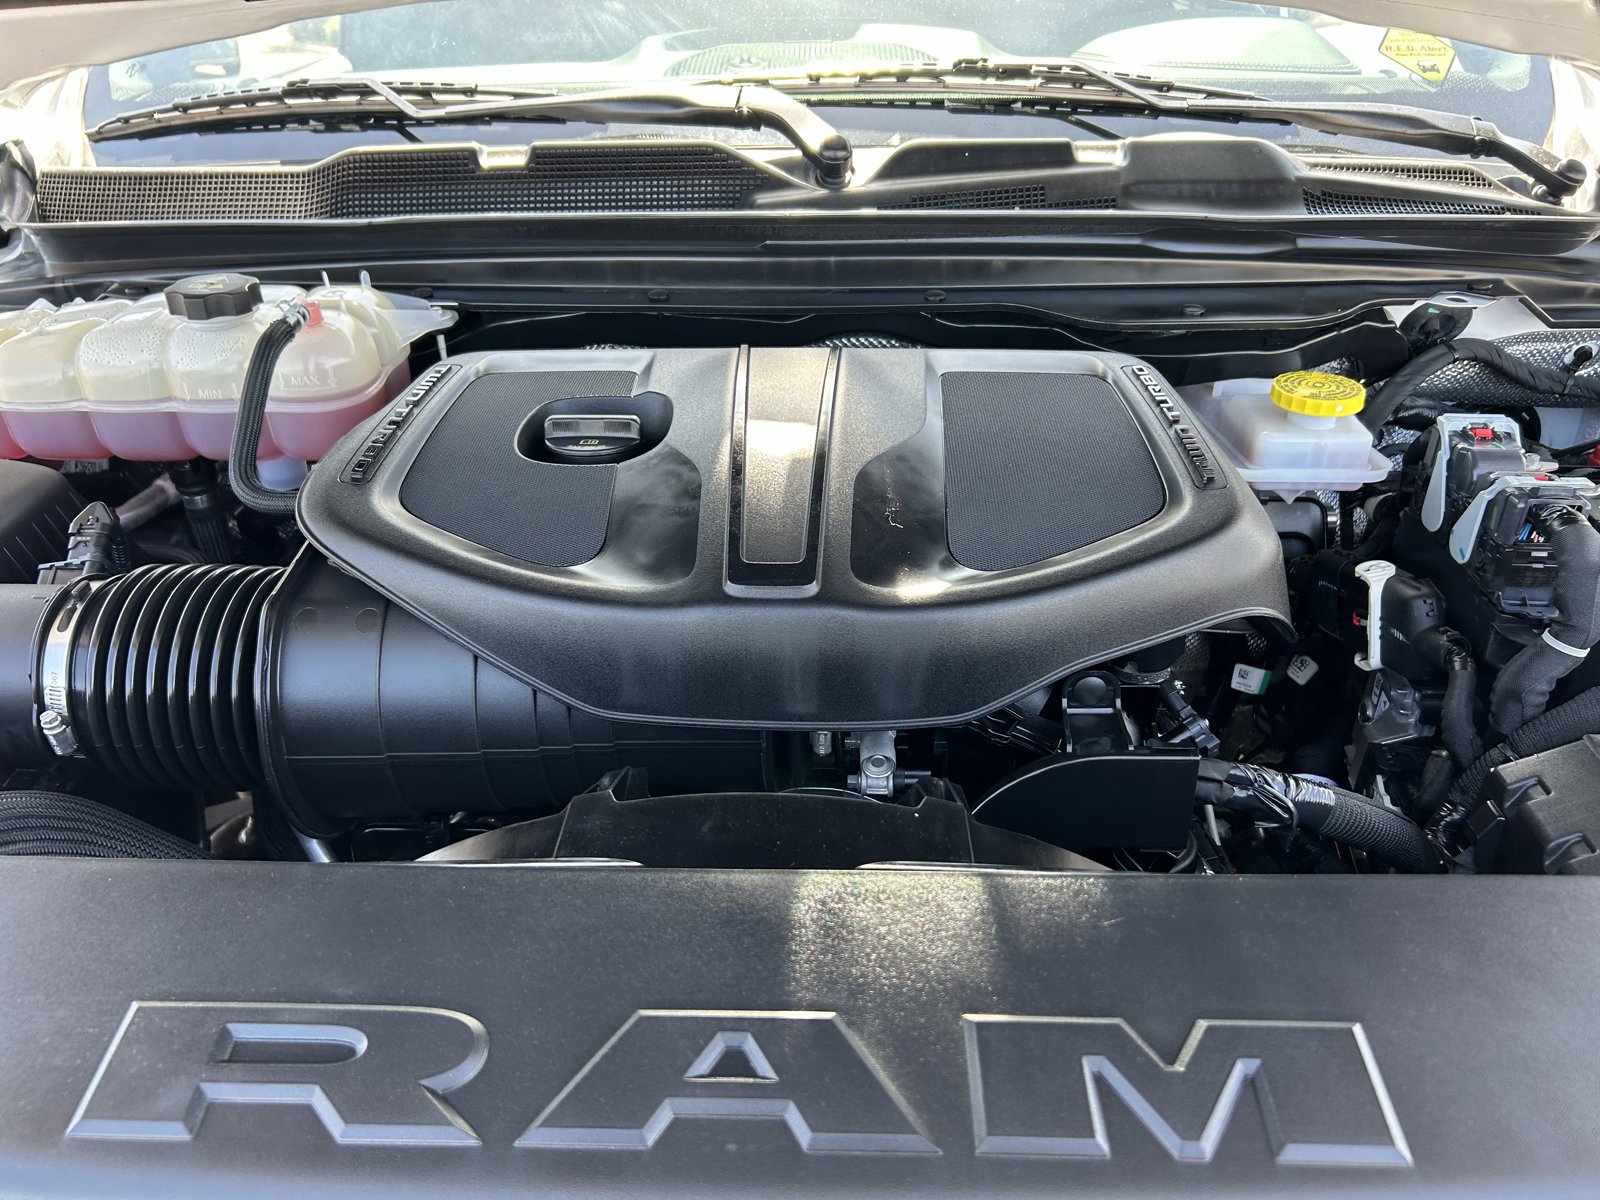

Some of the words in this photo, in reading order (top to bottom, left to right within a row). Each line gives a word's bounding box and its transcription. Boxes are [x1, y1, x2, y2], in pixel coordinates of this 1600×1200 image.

[1420, 45, 1448, 53] Alert
[199, 389, 222, 399] MIN
[291, 375, 320, 386] MAX
[405, 364, 452, 406] TWIN
[1131, 365, 1181, 425] TURBO
[350, 404, 413, 479] TURBO
[1174, 424, 1216, 484] TWIN
[65, 1001, 1415, 1166] RAM
